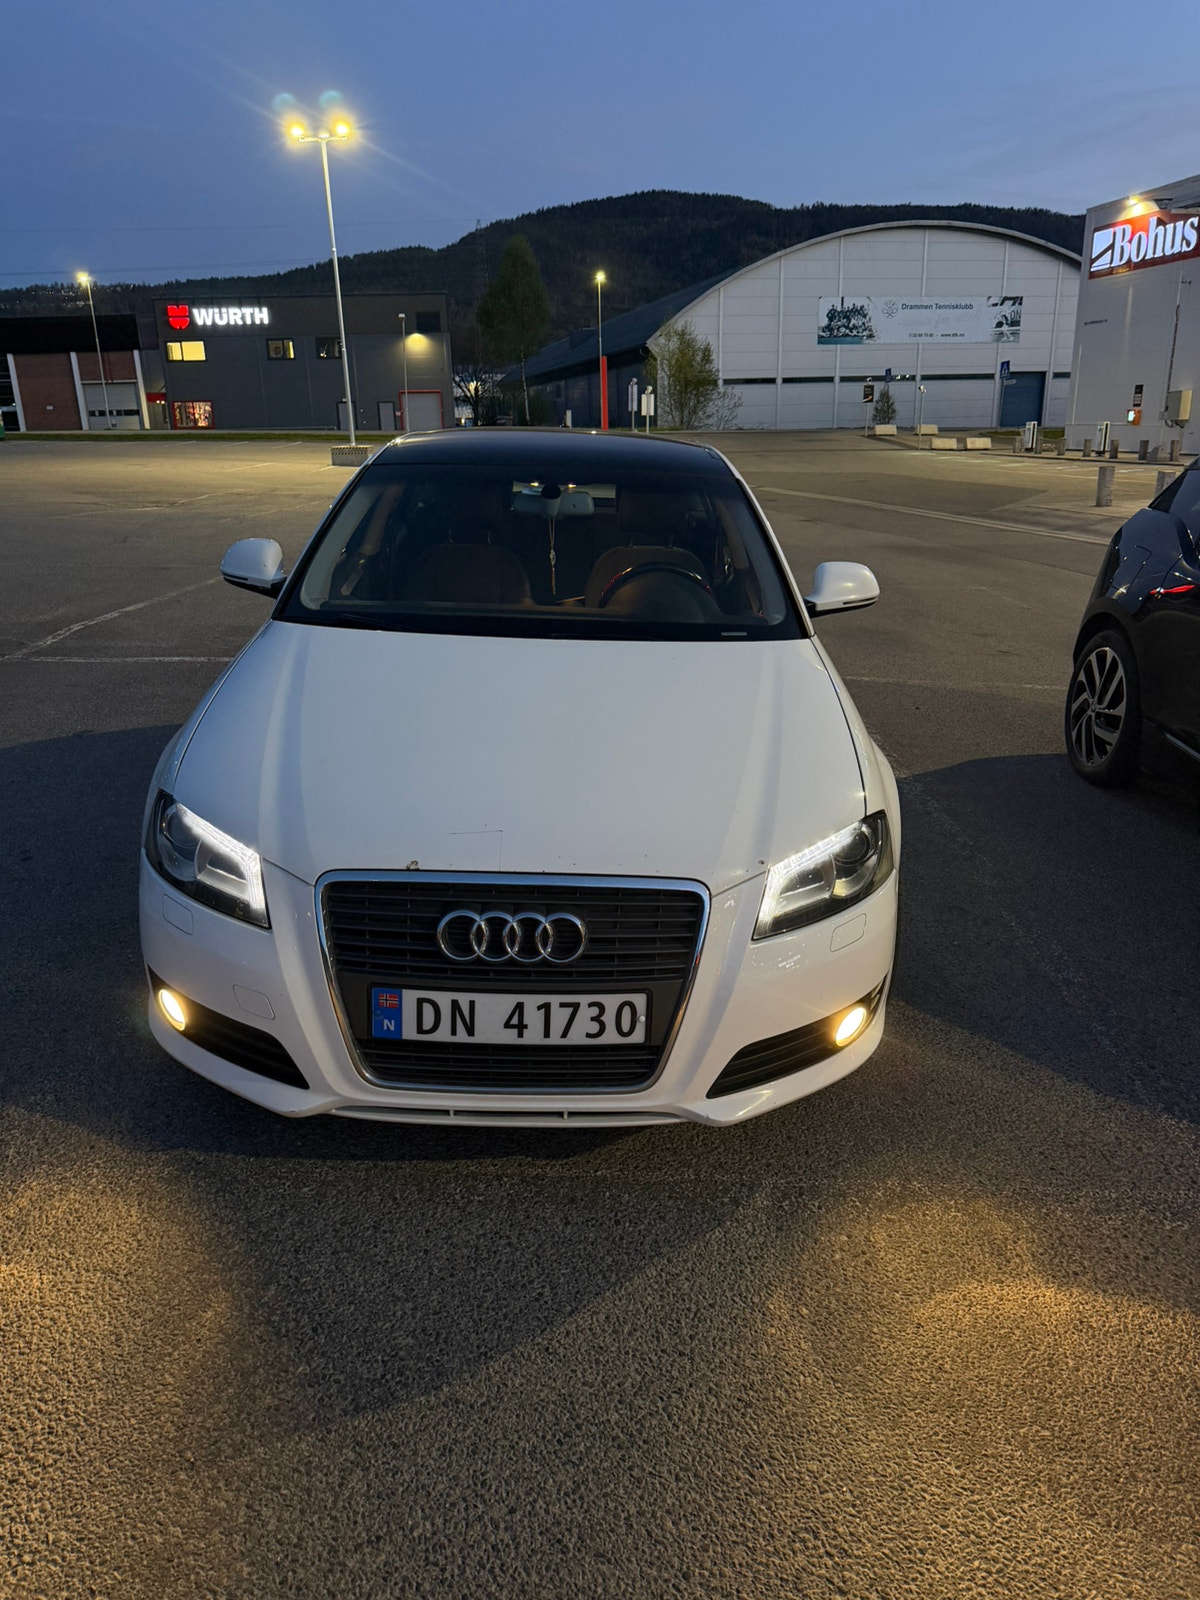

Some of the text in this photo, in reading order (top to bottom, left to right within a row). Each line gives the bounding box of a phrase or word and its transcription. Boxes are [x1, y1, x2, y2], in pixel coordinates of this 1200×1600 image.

[1111, 216, 1199, 267] Bohus
[935, 302, 974, 310] Tennisklubb
[192, 307, 269, 326] WÜRTH
[383, 1019, 395, 1031] N
[416, 997, 638, 1039] DN 41730
